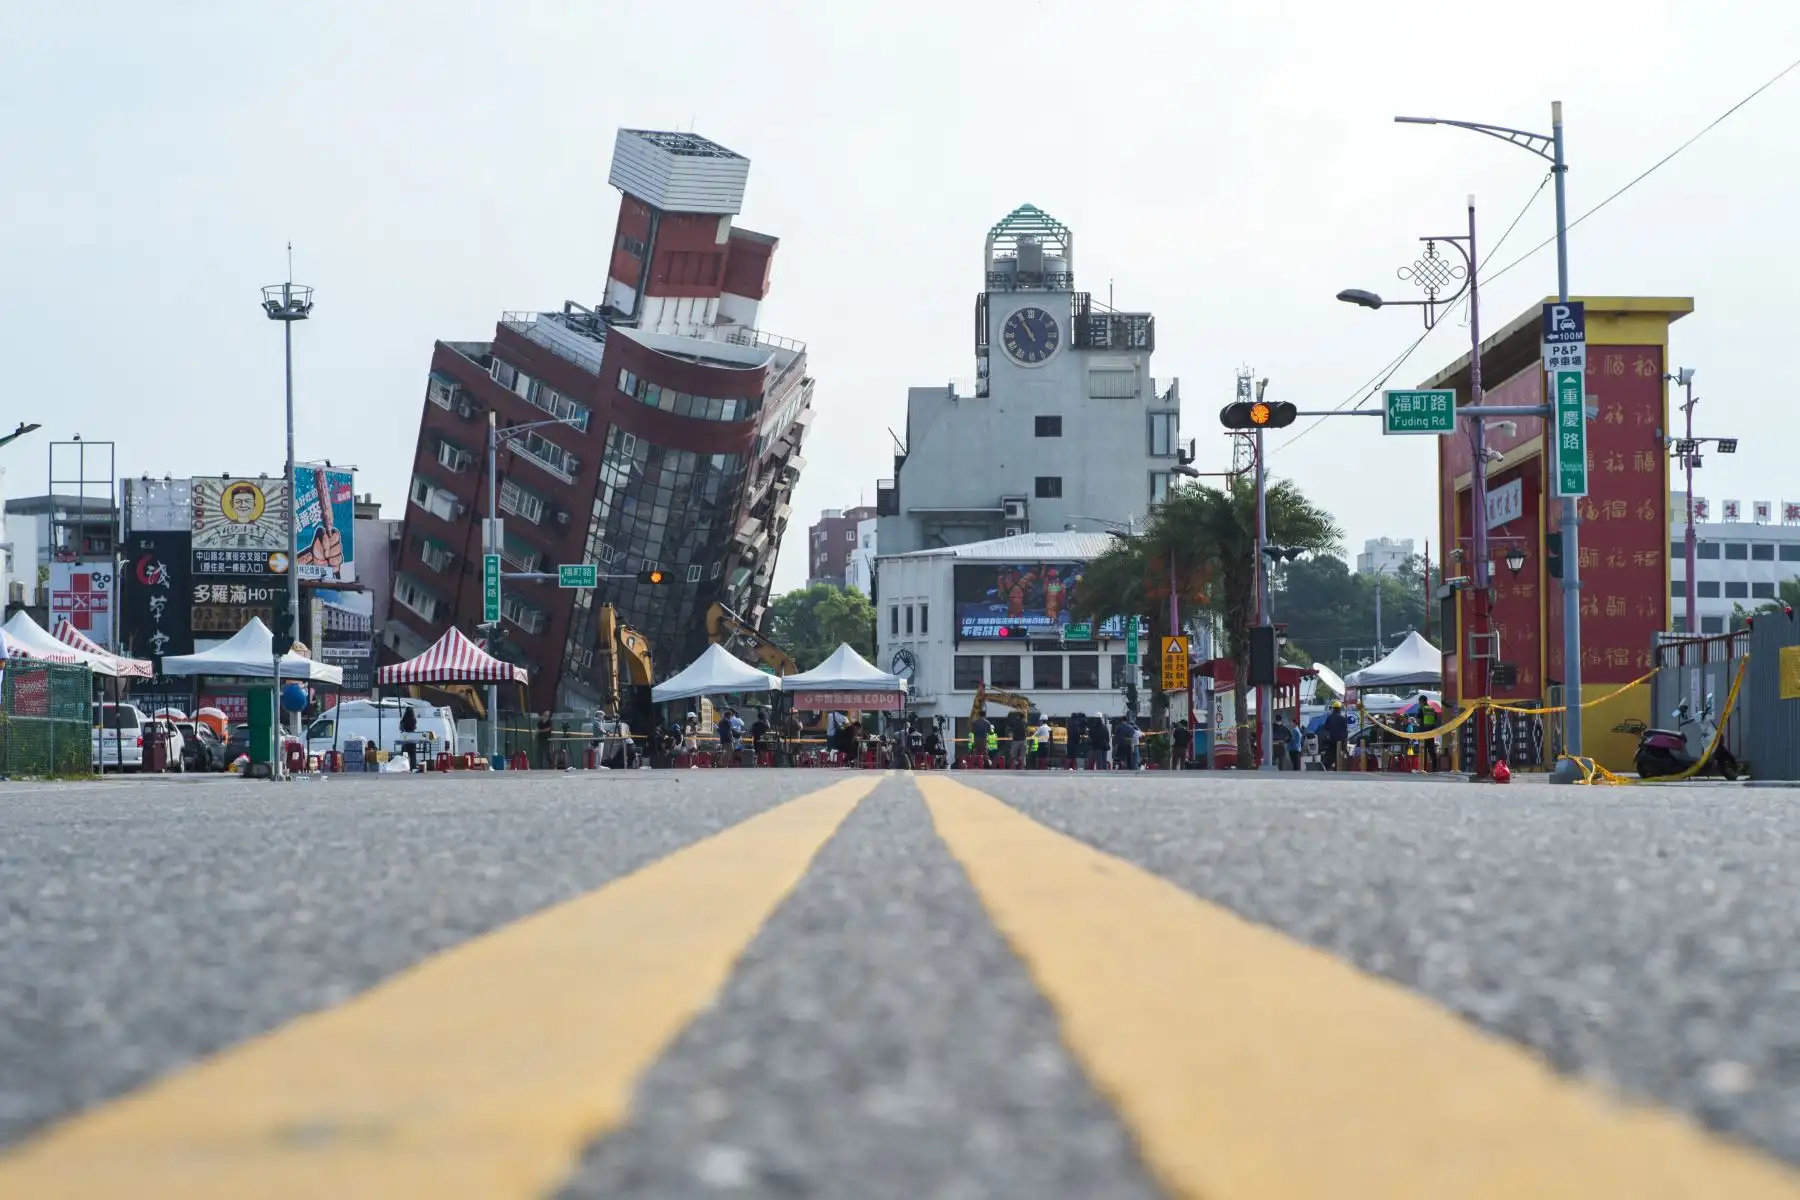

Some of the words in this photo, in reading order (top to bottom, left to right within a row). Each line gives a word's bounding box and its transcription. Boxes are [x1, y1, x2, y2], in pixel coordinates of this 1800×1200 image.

[1552, 305, 1570, 331] P
[1560, 332, 1583, 340] 100M
[1552, 346, 1578, 355] P&P
[1549, 356, 1581, 367] 停車場
[1395, 395, 1447, 411] 福町路
[1395, 416, 1429, 427] Fuding
[1432, 416, 1447, 426] Rd.
[1562, 388, 1580, 450] 重慶路
[193, 584, 247, 604] 多羅滿
